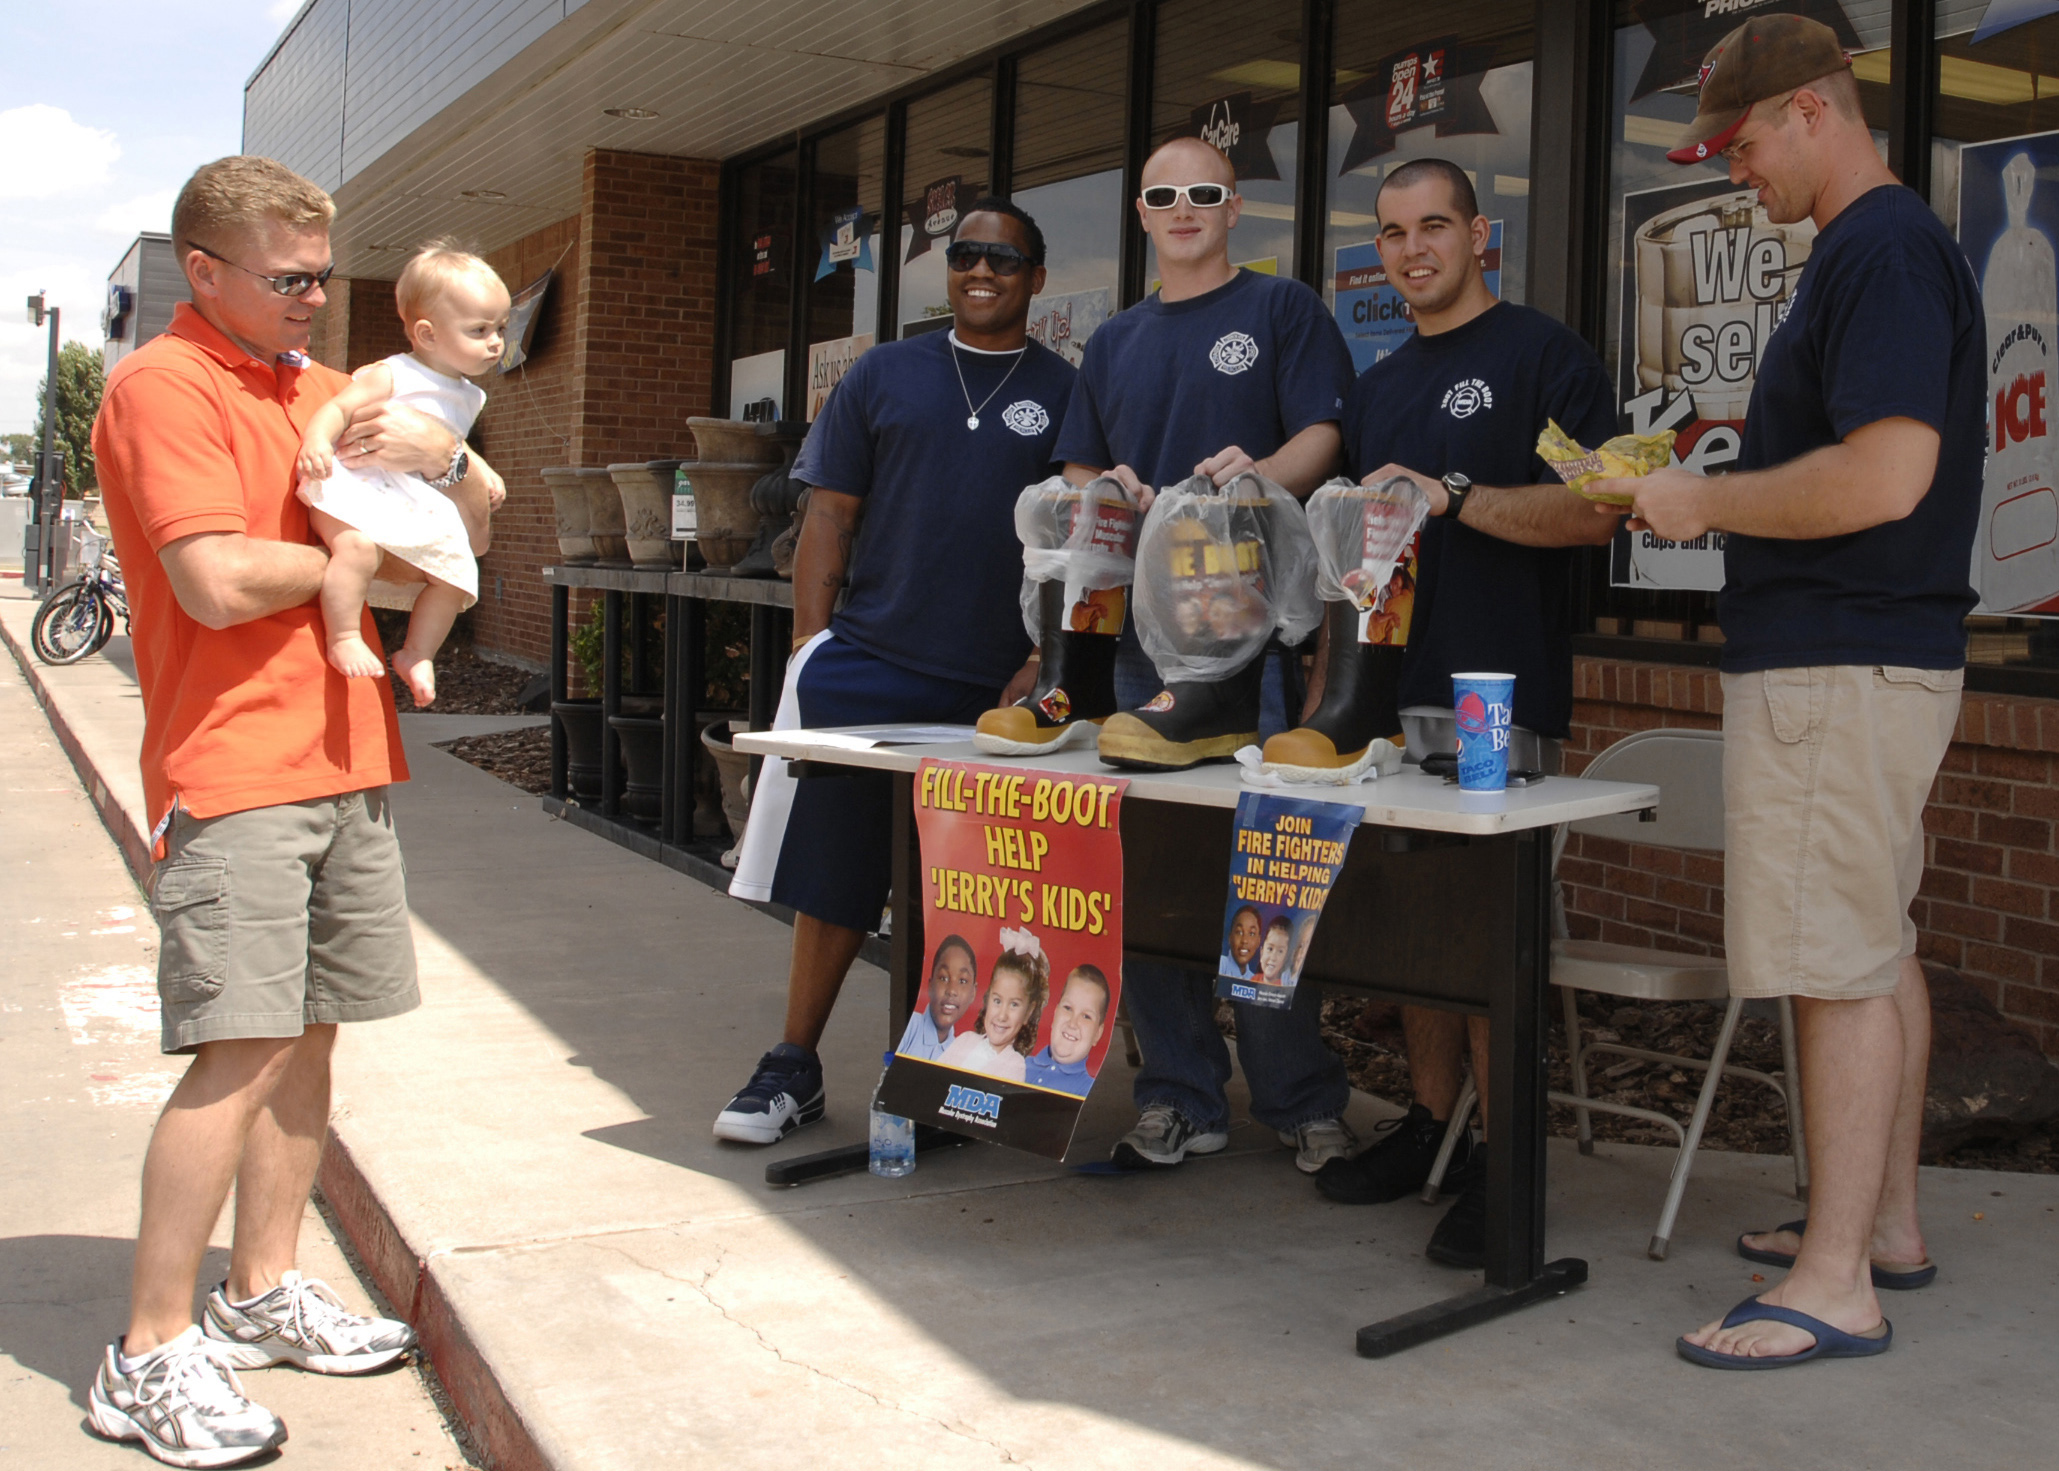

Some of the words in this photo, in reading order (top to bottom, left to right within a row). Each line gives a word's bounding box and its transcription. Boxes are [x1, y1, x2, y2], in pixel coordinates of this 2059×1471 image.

[1392, 66, 1417, 83] open
[1393, 56, 1418, 73] pumps
[1389, 77, 1415, 115] 24
[1201, 119, 1240, 150] CarCare
[1349, 274, 1362, 286] Find
[1363, 273, 1368, 283] it
[1690, 227, 1786, 305] We
[1352, 292, 1405, 325] Click
[1050, 302, 1072, 352] Up!
[1679, 301, 1788, 386] sel
[812, 350, 829, 391] Ask
[830, 359, 842, 388] us
[1454, 379, 1469, 391] FILL
[1471, 378, 1485, 389] THE
[1481, 385, 1493, 409] BOOT
[1996, 369, 2047, 453] ICE
[1642, 532, 1677, 552] cups
[1712, 532, 1727, 551] ic
[1487, 702, 1513, 727] Ta
[1490, 726, 1511, 752] Be
[1461, 759, 1495, 776] TACO
[1464, 767, 1498, 784] BELL
[921, 765, 1119, 829] FILL-THE-BOOT
[1275, 814, 1312, 836] JOIN
[983, 825, 1049, 872] HELP
[1237, 829, 1273, 857] FIRE
[1275, 834, 1346, 866] FIGHTERS
[1246, 857, 1266, 876] IN
[1268, 860, 1331, 885] HELPING
[931, 867, 1036, 924] 'JERRY'S
[1041, 883, 1112, 936] KIDS'
[1231, 983, 1257, 1000] MDA
[944, 1084, 1003, 1119] MDA
